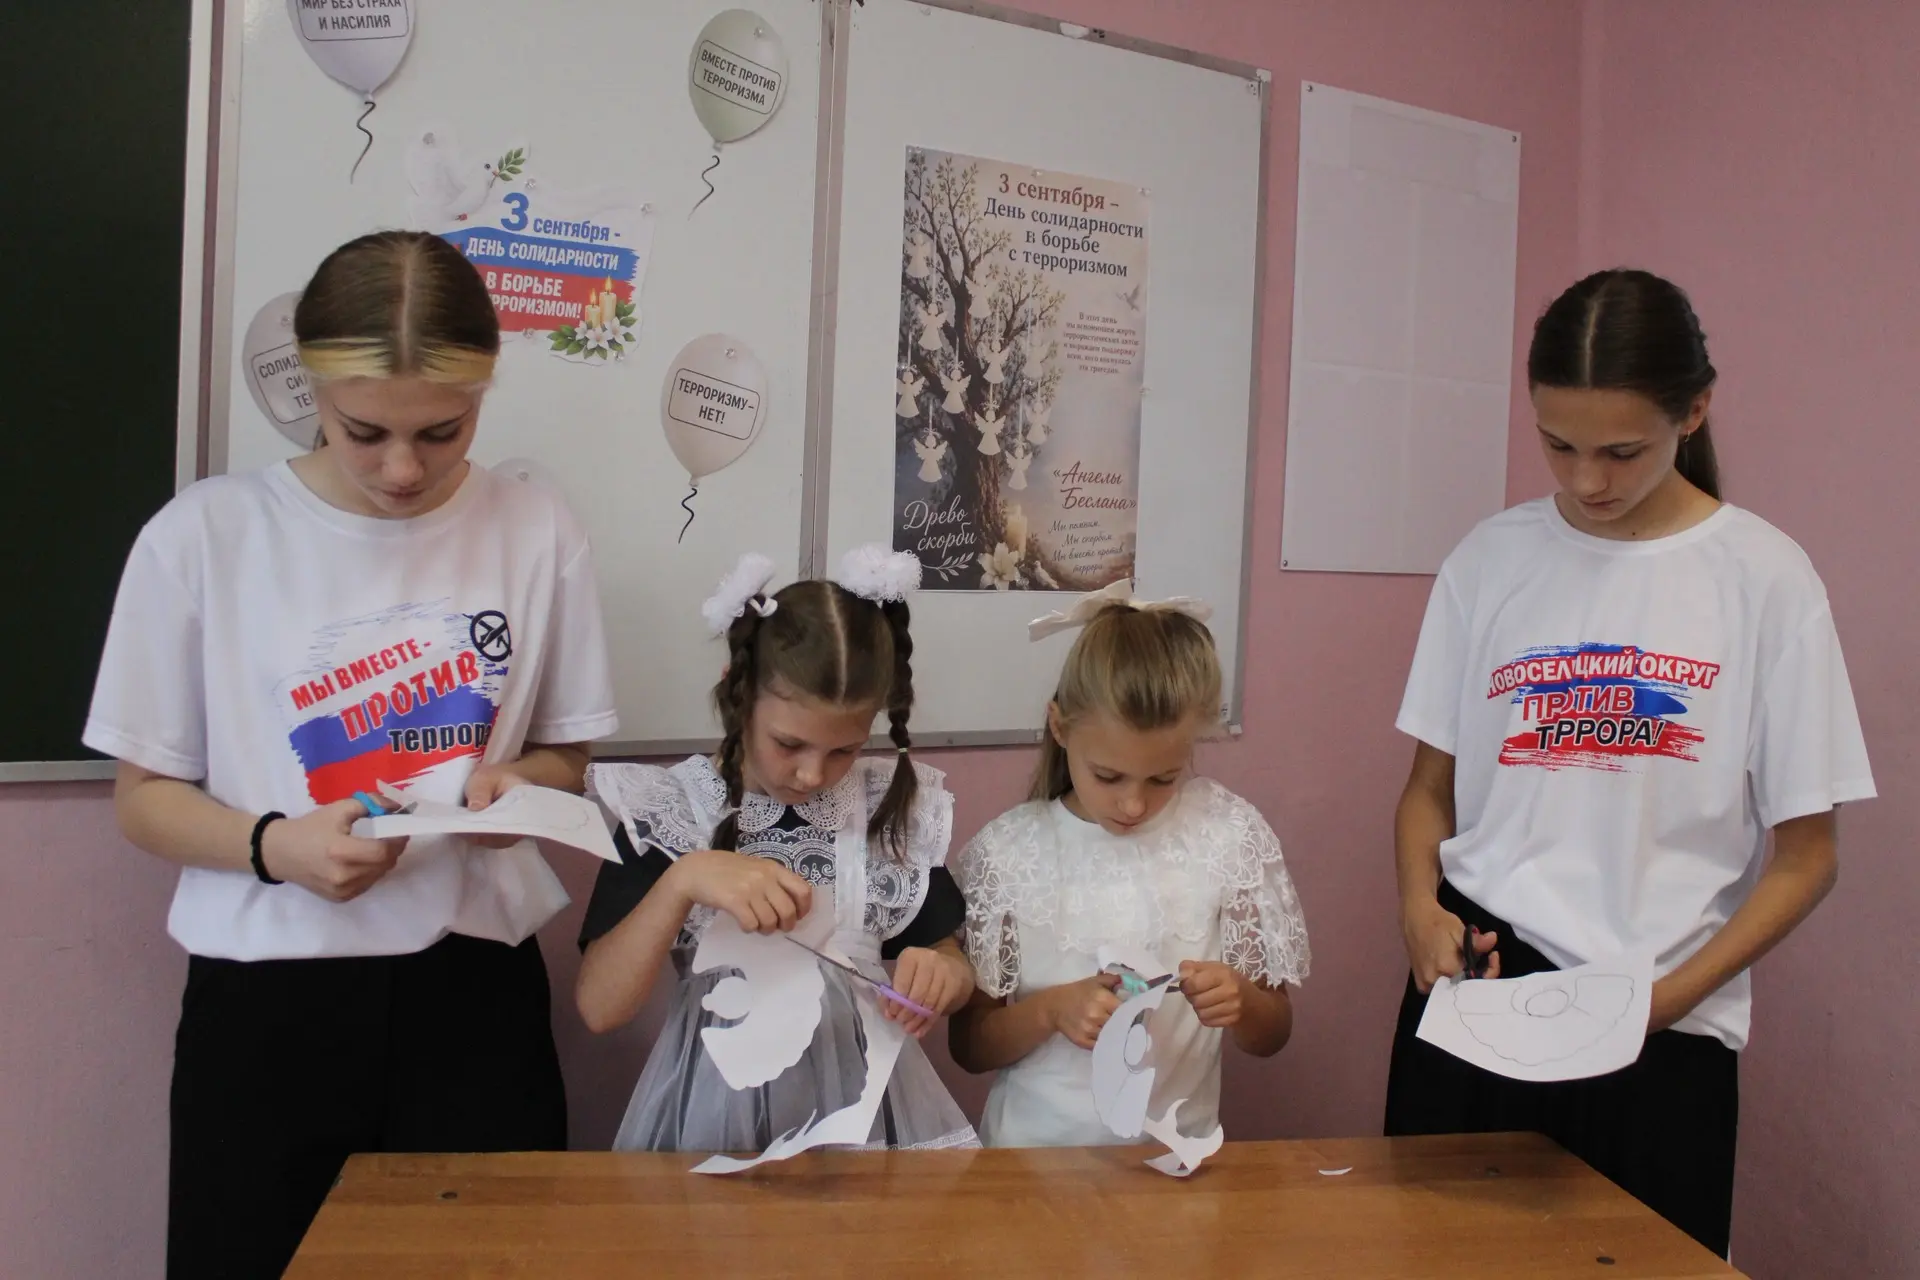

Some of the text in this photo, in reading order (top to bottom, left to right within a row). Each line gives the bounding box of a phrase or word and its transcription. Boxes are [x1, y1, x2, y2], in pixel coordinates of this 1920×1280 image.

[318, 14, 391, 30] И НАСИЛИЯ
[701, 49, 776, 91] ВМЕСТЕ ПРОТИВ
[703, 68, 765, 105] ТЕРРОРИЗМА
[999, 173, 1010, 194] 3
[1017, 181, 1105, 212] сентября
[501, 192, 529, 232] 3
[533, 217, 610, 242] сентября
[983, 197, 1144, 239] День солидарности
[465, 237, 619, 270] ДЕНЬ СОЛИДАРНОСТИ
[1025, 229, 1100, 253] в борьбе
[1008, 248, 1128, 277] с терроризмом
[486, 271, 563, 297] В БОРЬБЕ
[489, 293, 582, 318] РРОРИЗМОМ!
[698, 404, 726, 425] НЕТ!
[1053, 460, 1123, 485] «Ангелы
[903, 494, 969, 536] Древо
[1060, 487, 1137, 510] Беслана»
[917, 522, 977, 559] скорби
[290, 674, 336, 711] МЫ
[333, 638, 423, 691] ВМЕСТЕ
[1638, 654, 1719, 688] ОКРУГ
[339, 650, 479, 741] ПРОТИВ
